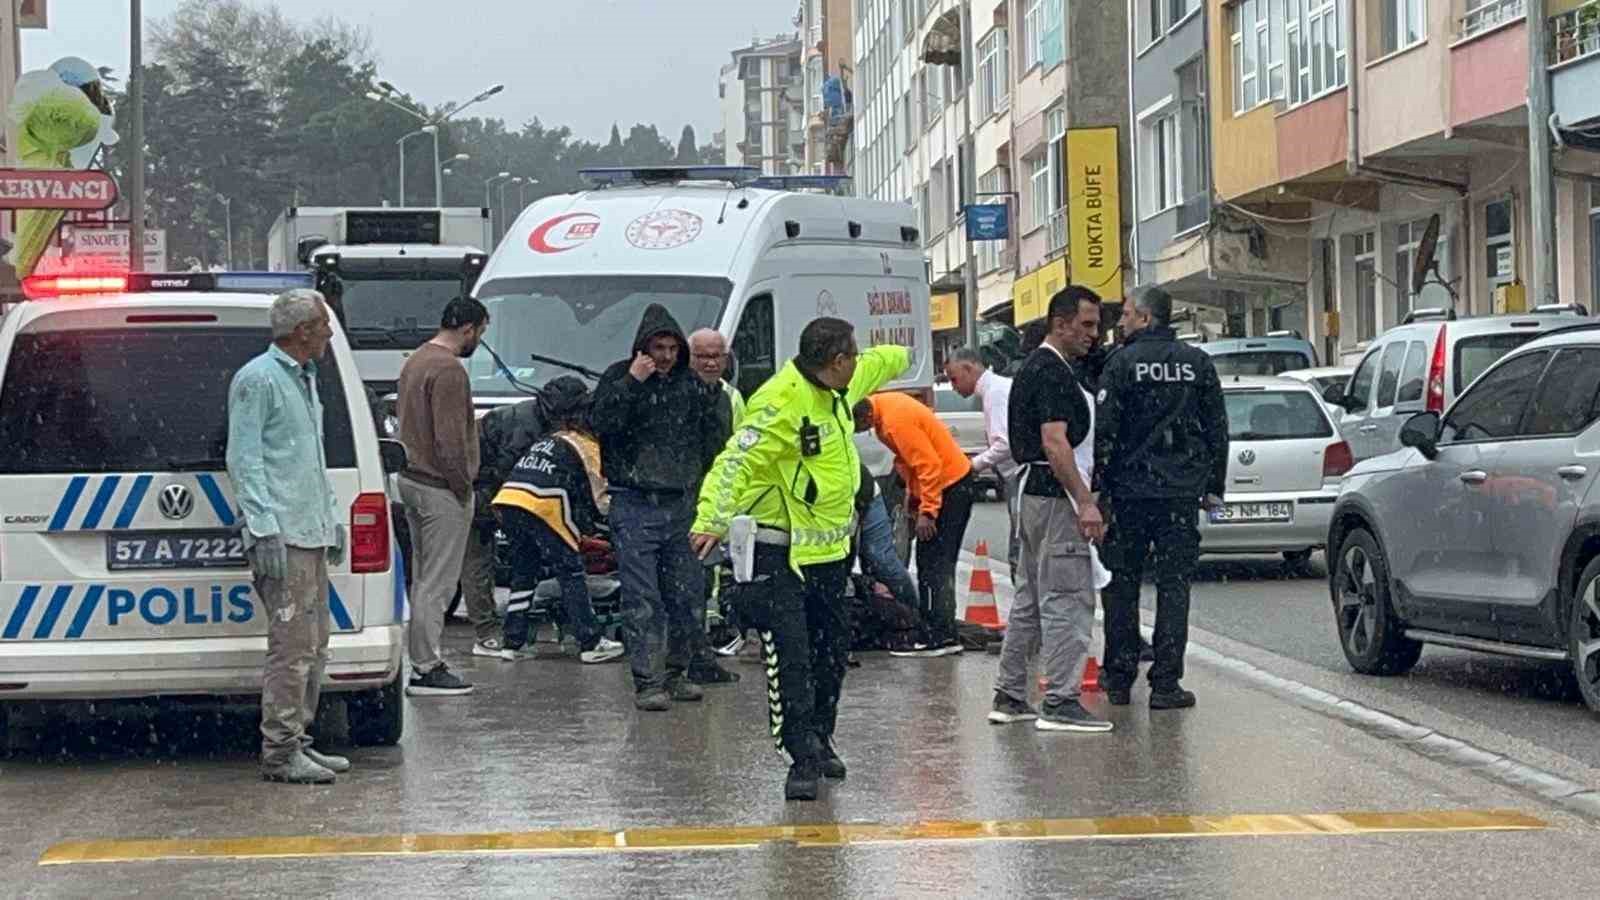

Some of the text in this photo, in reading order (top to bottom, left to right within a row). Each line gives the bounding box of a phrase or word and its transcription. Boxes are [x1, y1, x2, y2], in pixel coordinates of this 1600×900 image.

[1082, 164, 1104, 269] NOKTA BÜFE
[513, 453, 557, 475] AĞLIK
[115, 538, 244, 560] 57 A 7222
